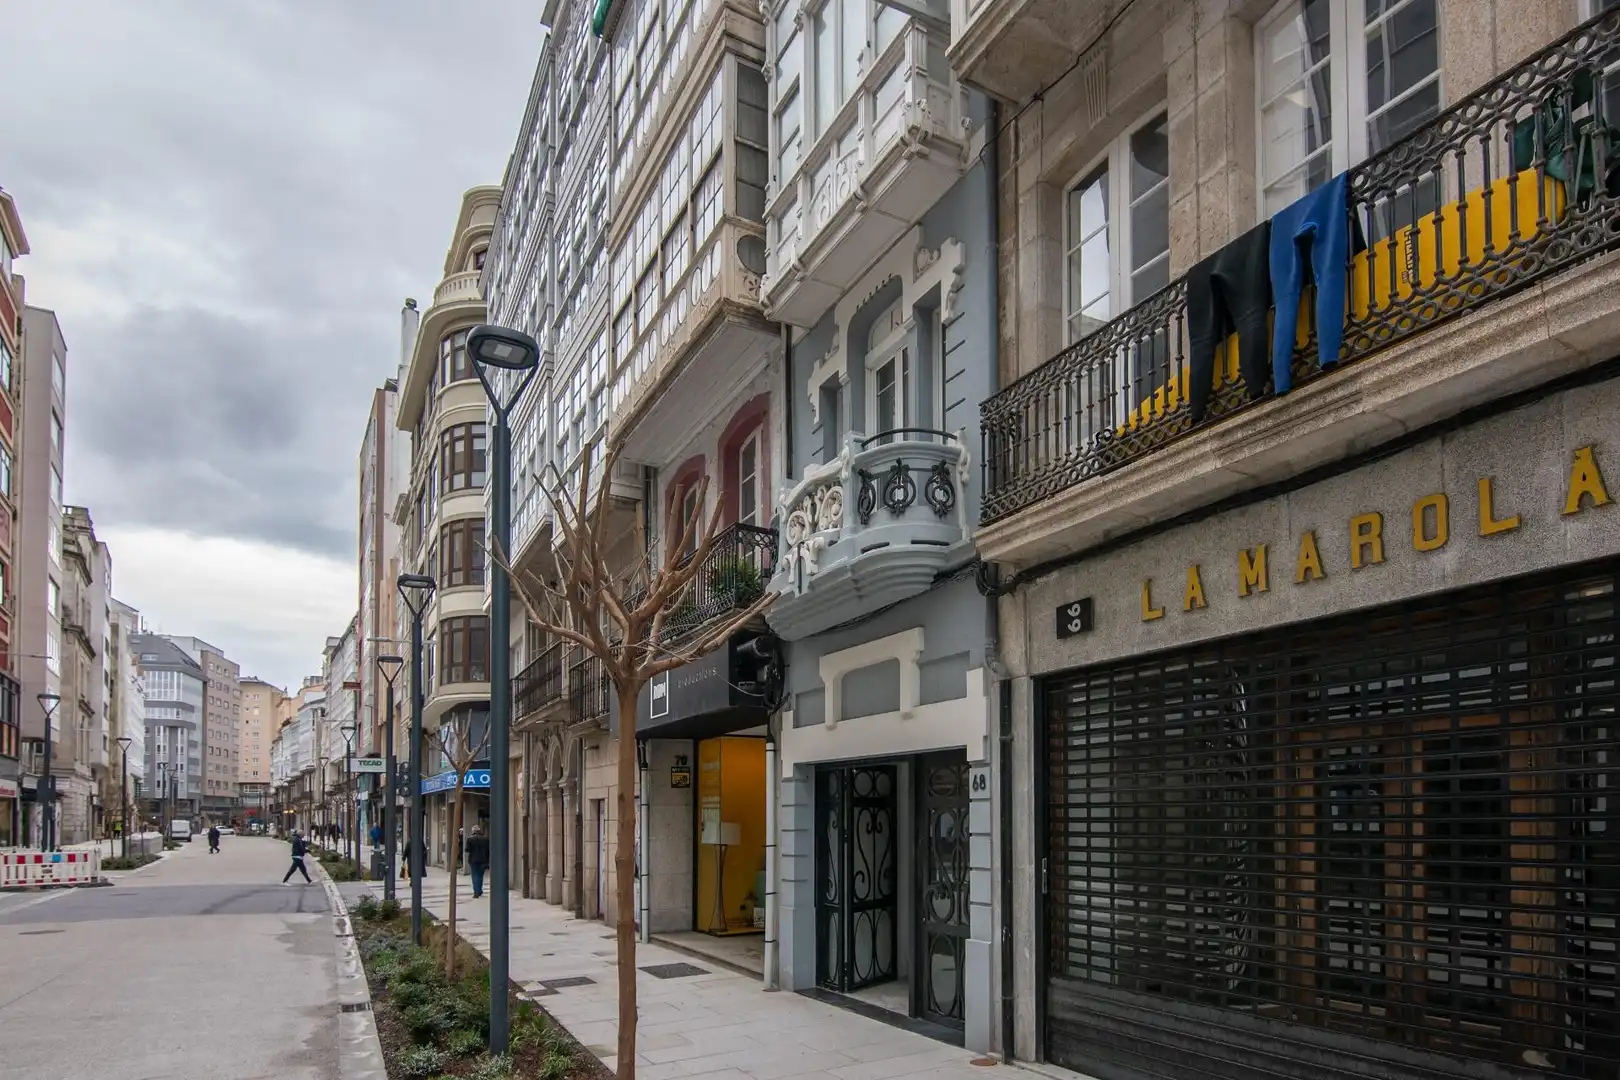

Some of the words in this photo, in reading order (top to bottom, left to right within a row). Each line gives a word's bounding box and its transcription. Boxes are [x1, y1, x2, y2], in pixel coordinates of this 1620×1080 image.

[1141, 564, 1208, 622] LA
[1237, 444, 1615, 597] MAROLA
[1067, 603, 1081, 632] 66
[675, 755, 687, 765] 70
[972, 774, 986, 791] 68
